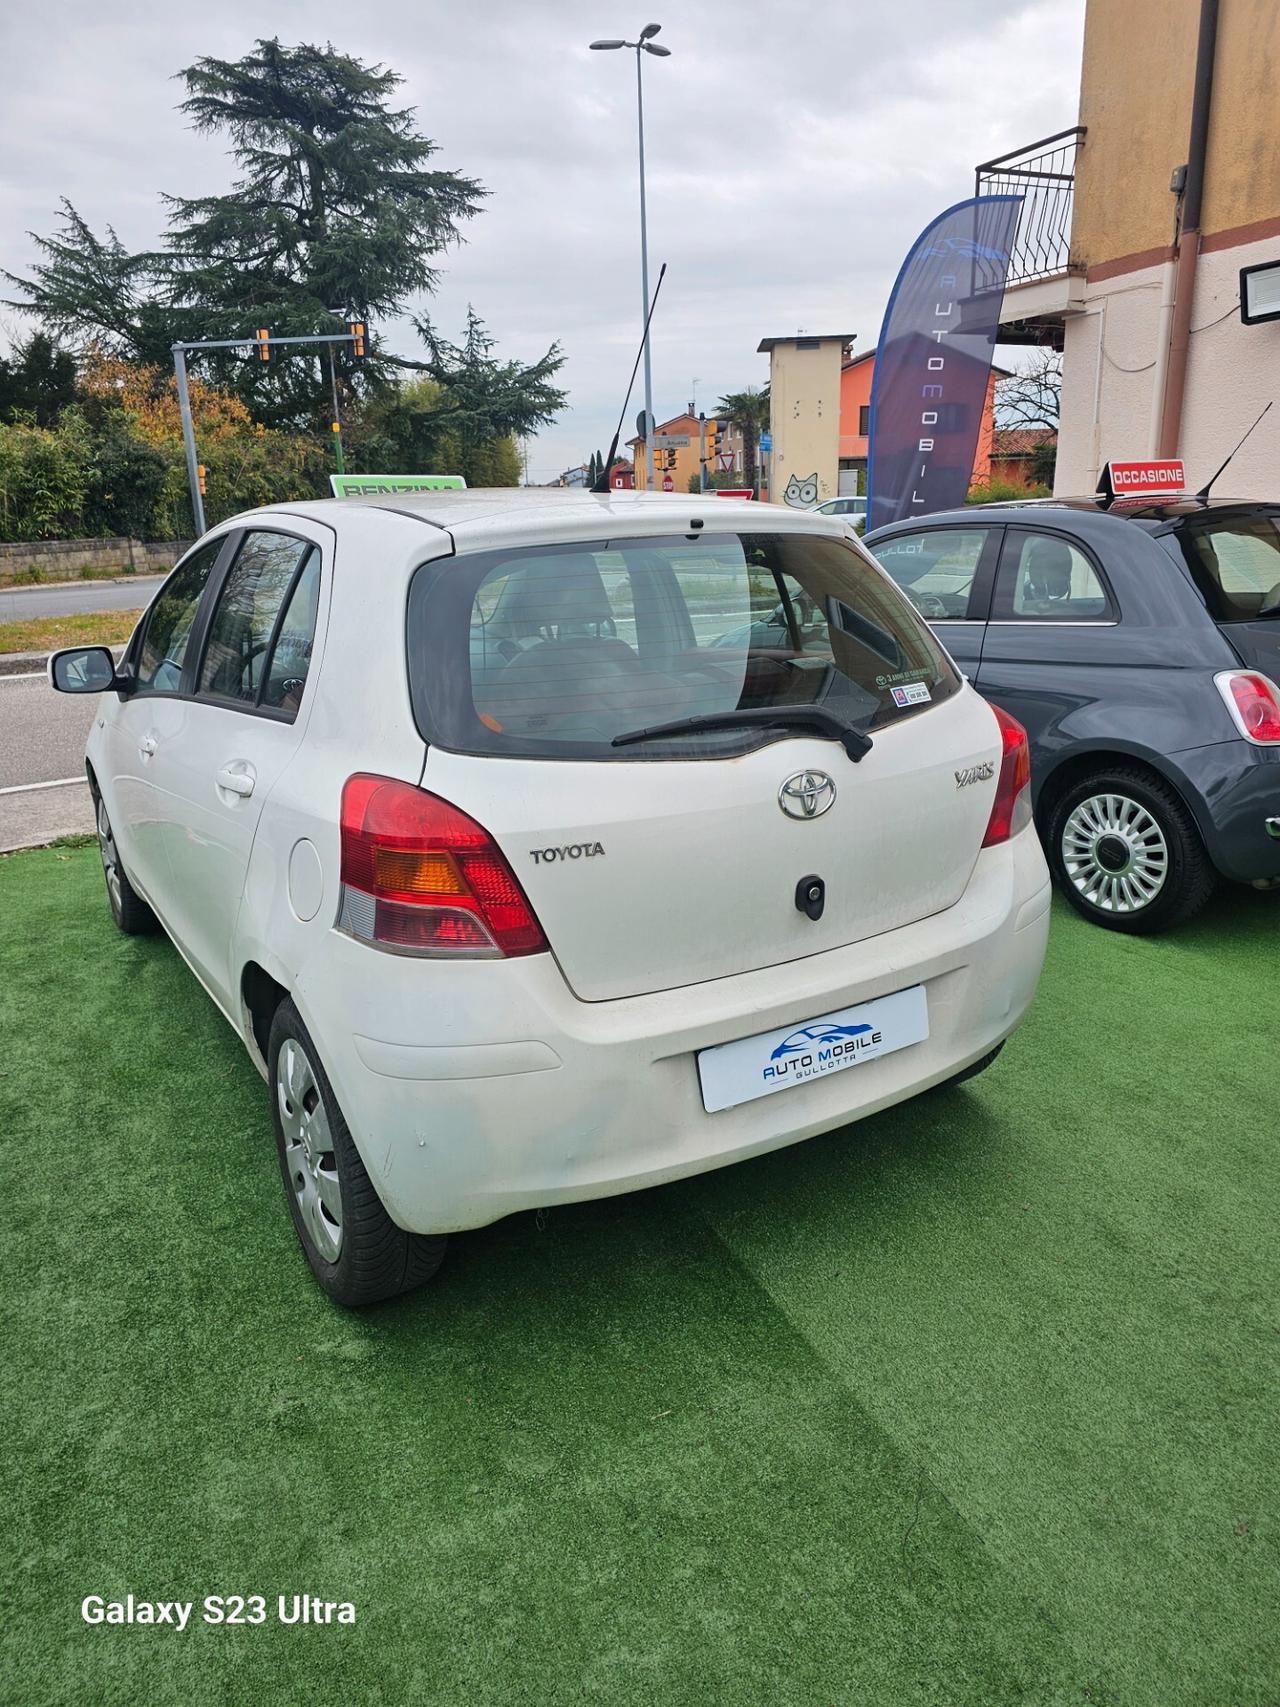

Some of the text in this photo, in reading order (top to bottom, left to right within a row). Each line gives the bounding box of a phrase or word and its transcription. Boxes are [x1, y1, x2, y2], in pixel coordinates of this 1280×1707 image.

[909, 275, 957, 520] AUTOMOBIL
[663, 481, 673, 490] STOP
[1113, 469, 1184, 484] OCCASIONE
[529, 841, 606, 864] TOYOTA
[763, 1031, 882, 1080] AUTO MOBILE
[796, 1053, 857, 1080] GULLOTTA
